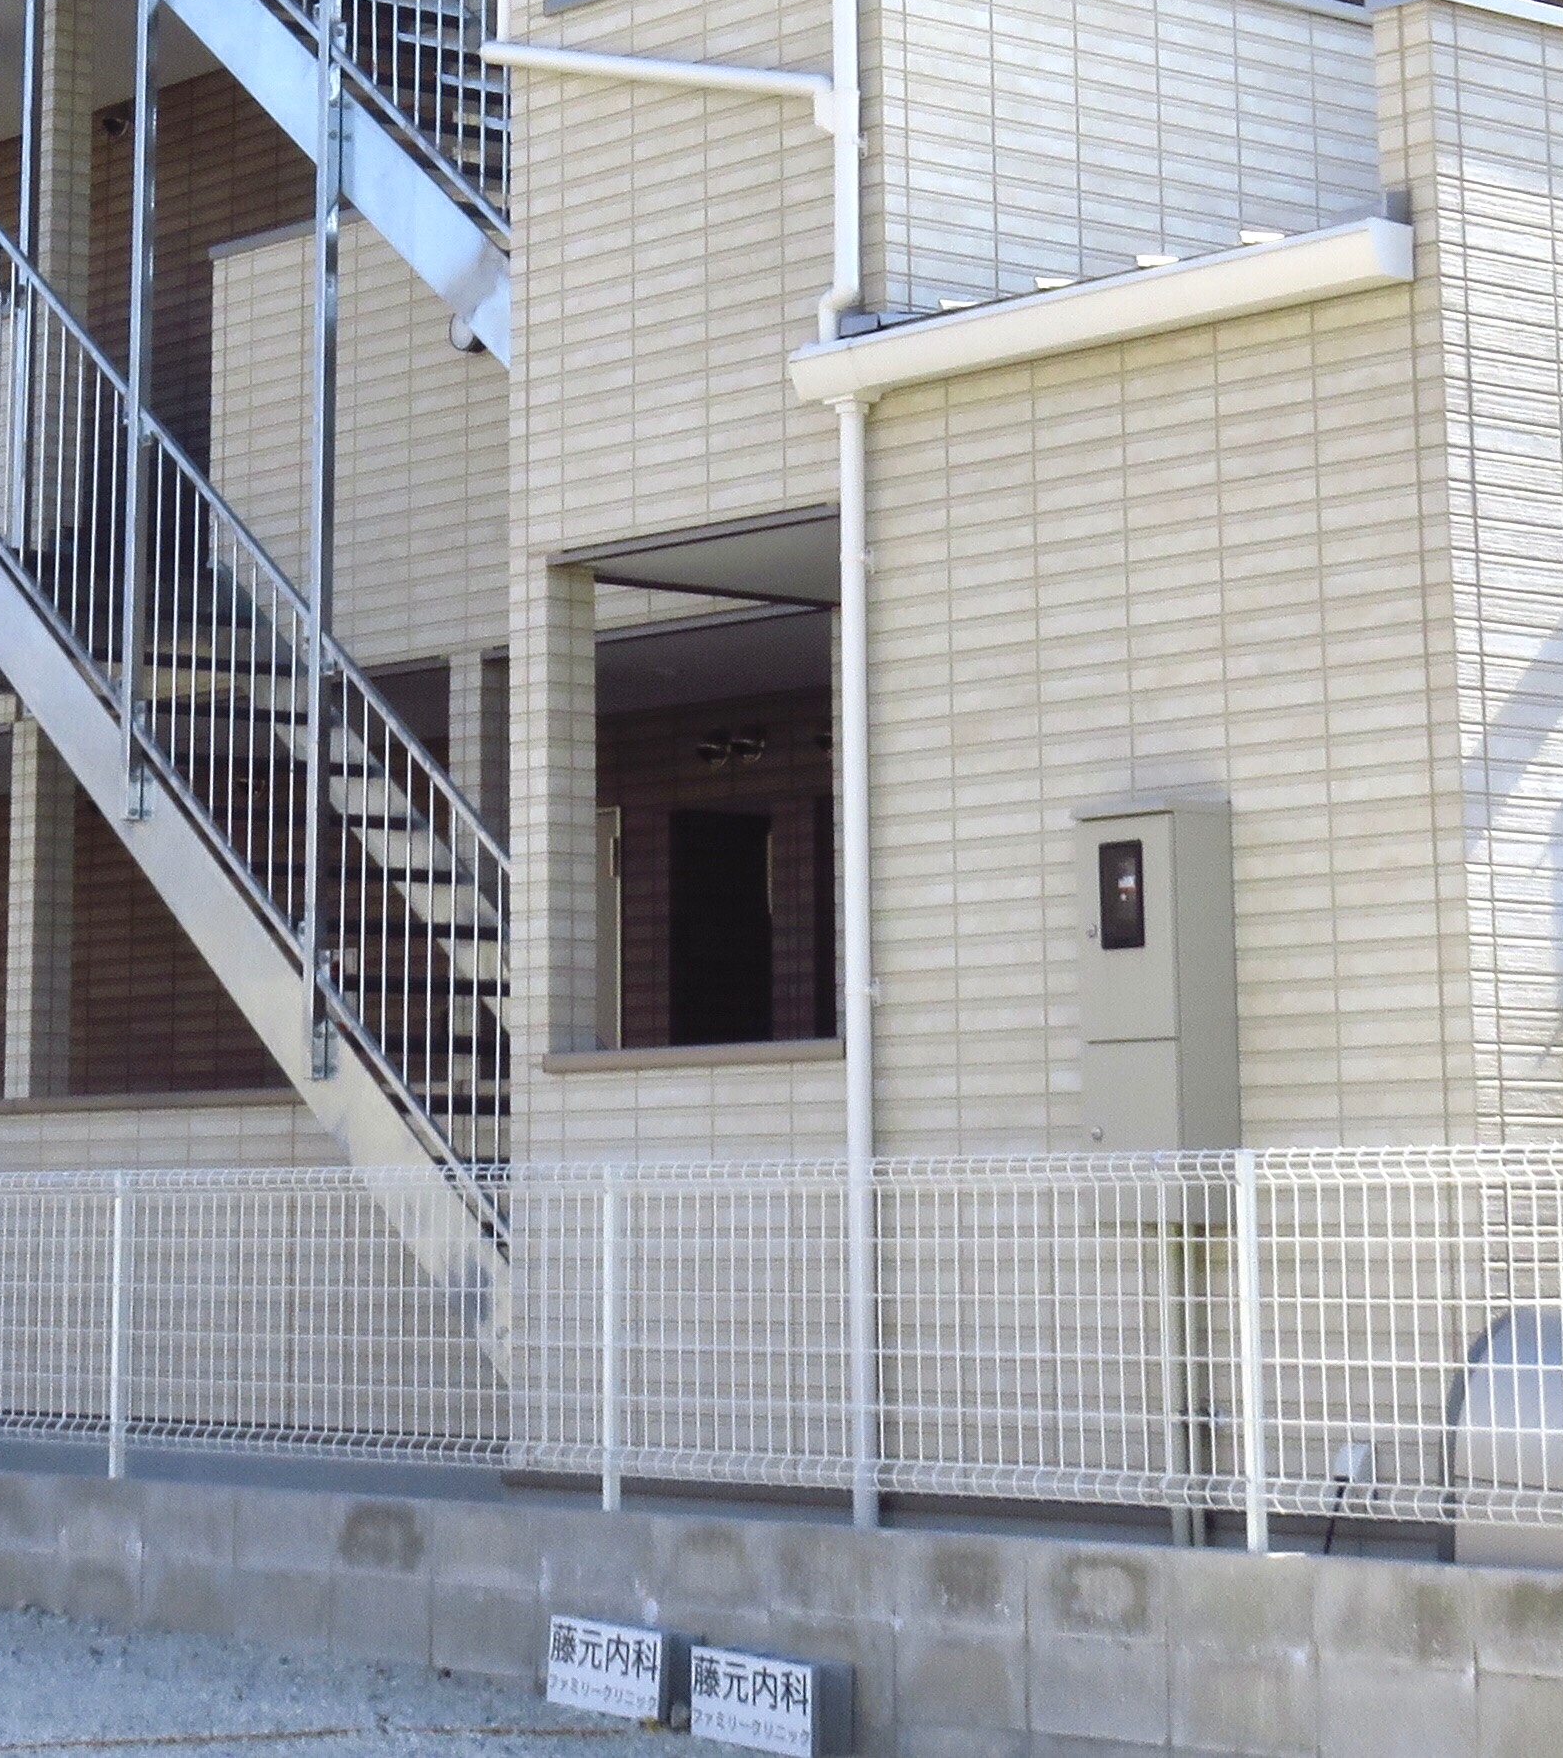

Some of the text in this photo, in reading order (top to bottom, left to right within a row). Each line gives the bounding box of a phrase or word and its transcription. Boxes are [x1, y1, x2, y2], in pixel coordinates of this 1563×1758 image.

[550, 1623, 658, 1682] 藤元内科
[549, 1673, 657, 1711] ファミリークリニック
[692, 1654, 809, 1716] 藤元内科
[693, 1708, 810, 1745] ファミリークリニック
